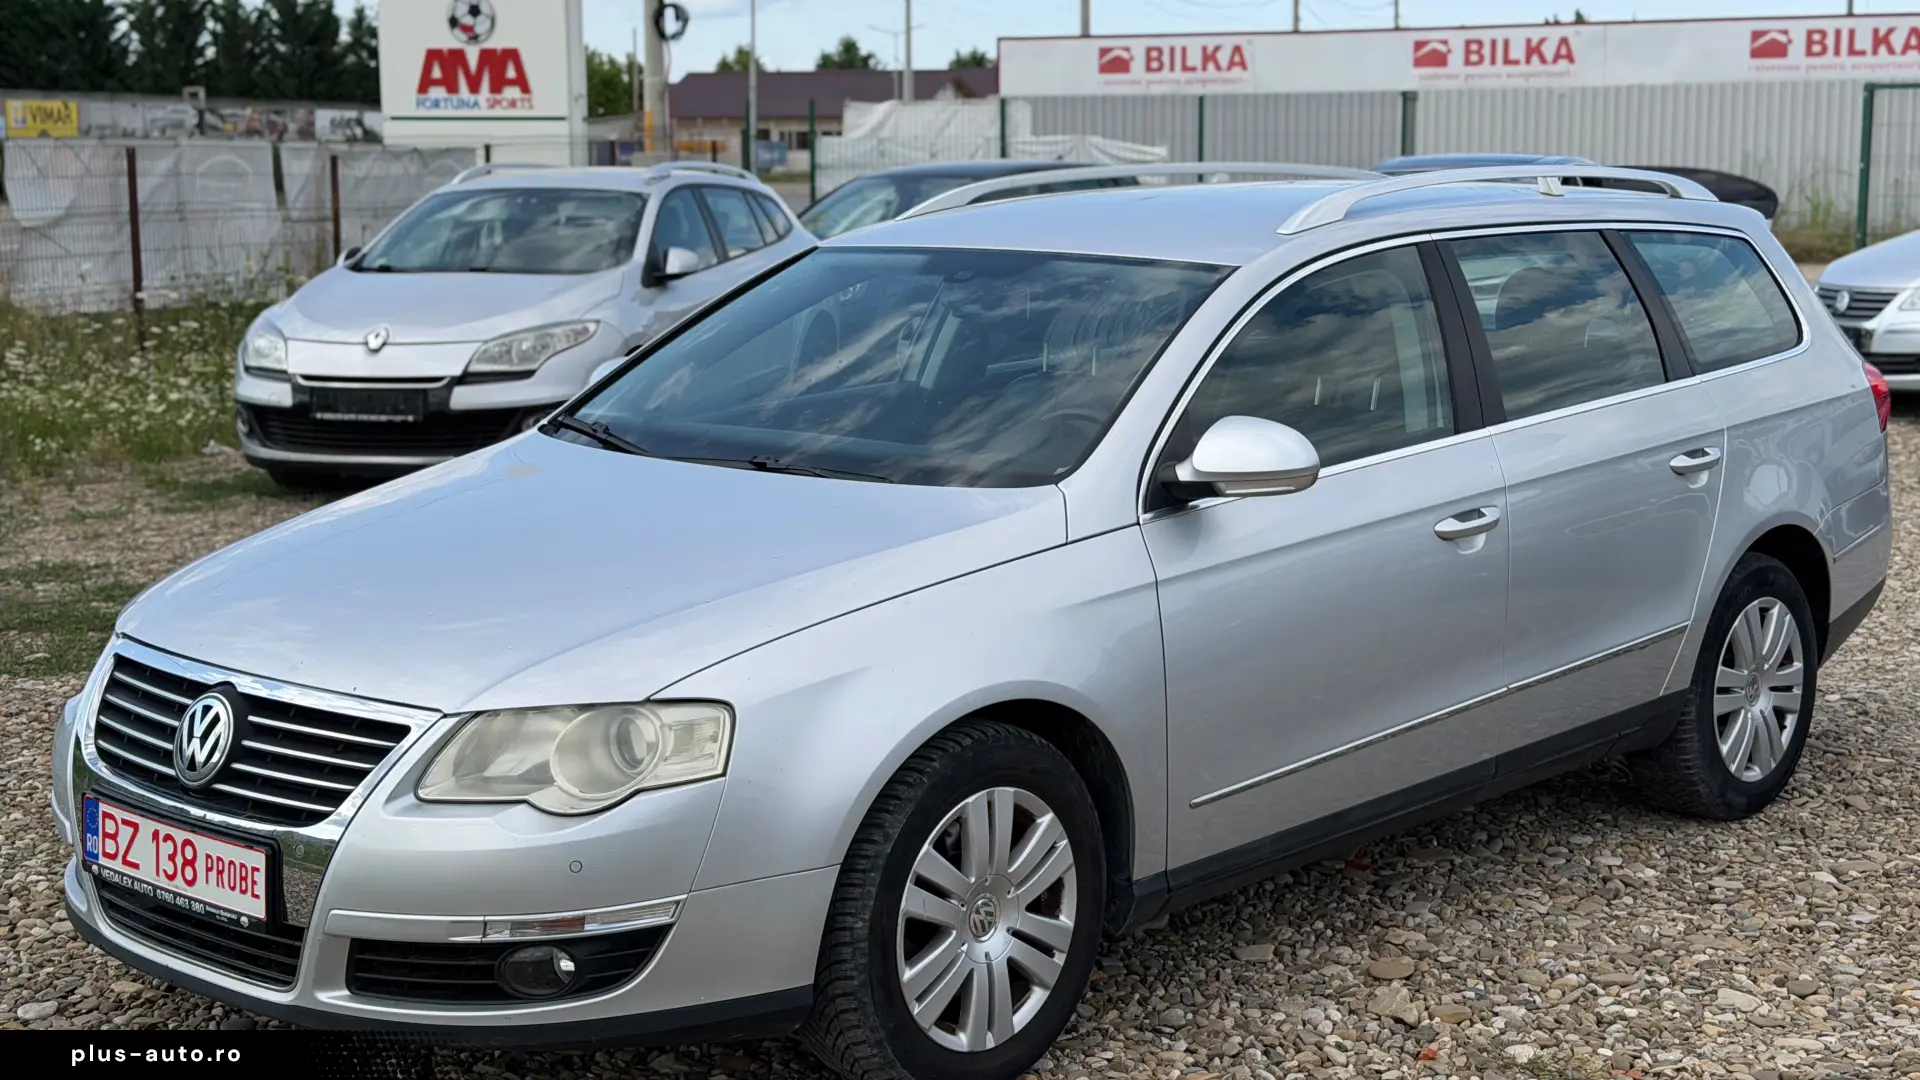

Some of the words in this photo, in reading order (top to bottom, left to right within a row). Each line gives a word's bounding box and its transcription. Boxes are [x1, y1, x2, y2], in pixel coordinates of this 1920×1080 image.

[1464, 36, 1575, 66] BILKA
[1805, 26, 1920, 57] BILKA
[417, 48, 532, 95] AMA
[1145, 44, 1248, 73] BILKA
[416, 97, 481, 110] FORTUNA
[486, 97, 534, 110] SPORTS
[86, 832, 99, 854] RO
[101, 809, 140, 871] BZ
[152, 828, 198, 887] 138
[205, 852, 261, 900] PROBE
[134, 882, 154, 897] AUTO
[156, 889, 175, 905] 0760
[175, 895, 190, 909] 463
